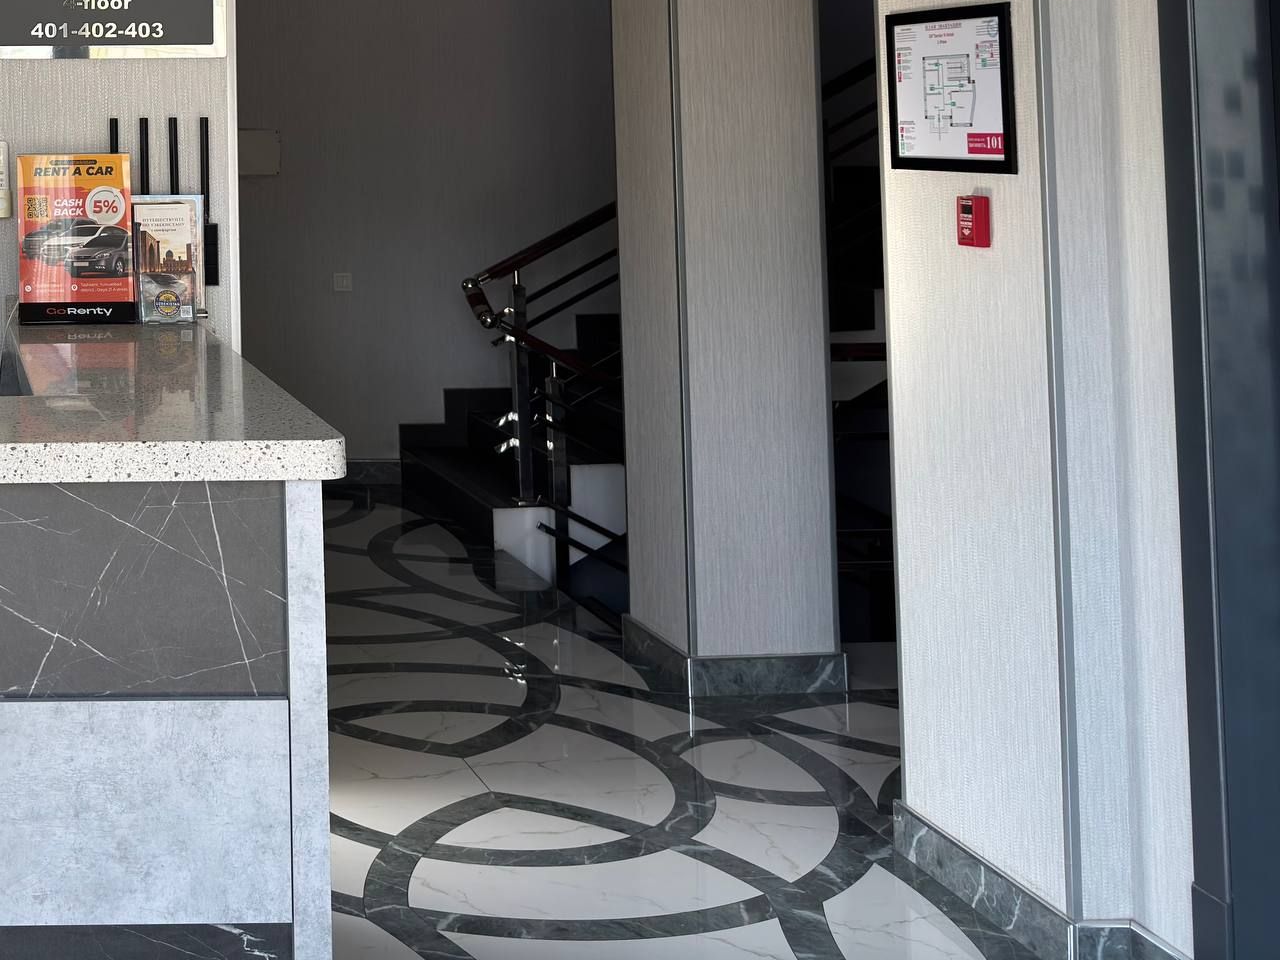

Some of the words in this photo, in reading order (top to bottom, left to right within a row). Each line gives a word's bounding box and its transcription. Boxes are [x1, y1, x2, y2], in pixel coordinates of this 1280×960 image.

[30, 22, 164, 38] 401-402-403
[986, 136, 1002, 149] 101
[34, 167, 69, 176] RENT
[72, 167, 82, 176] A
[86, 166, 114, 176] CAR
[54, 198, 83, 207] CASH
[93, 199, 118, 214] 5%
[54, 208, 83, 217] BACK
[46, 307, 113, 316] GoRenty
